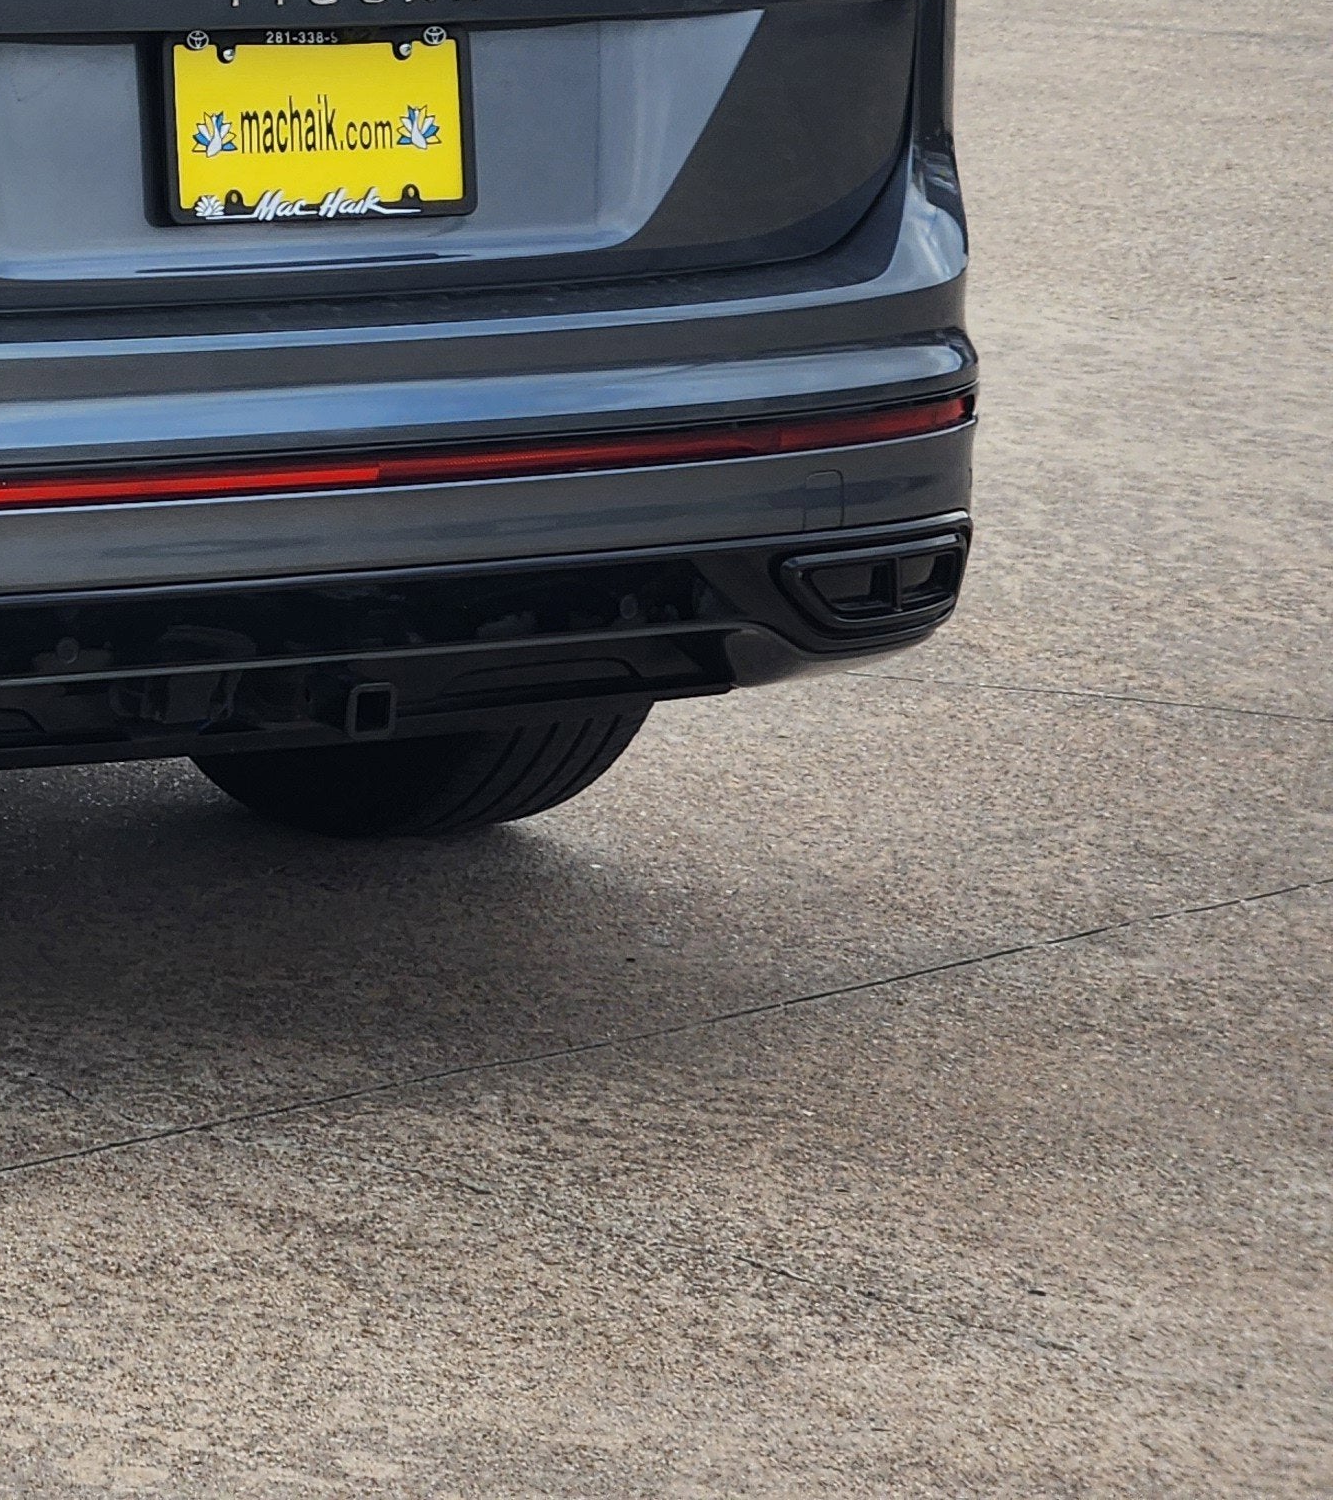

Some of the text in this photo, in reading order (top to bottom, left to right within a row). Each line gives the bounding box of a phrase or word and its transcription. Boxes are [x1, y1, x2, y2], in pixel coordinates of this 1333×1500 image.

[240, 94, 394, 154] machaik.com
[250, 187, 391, 221] Mac Haik
